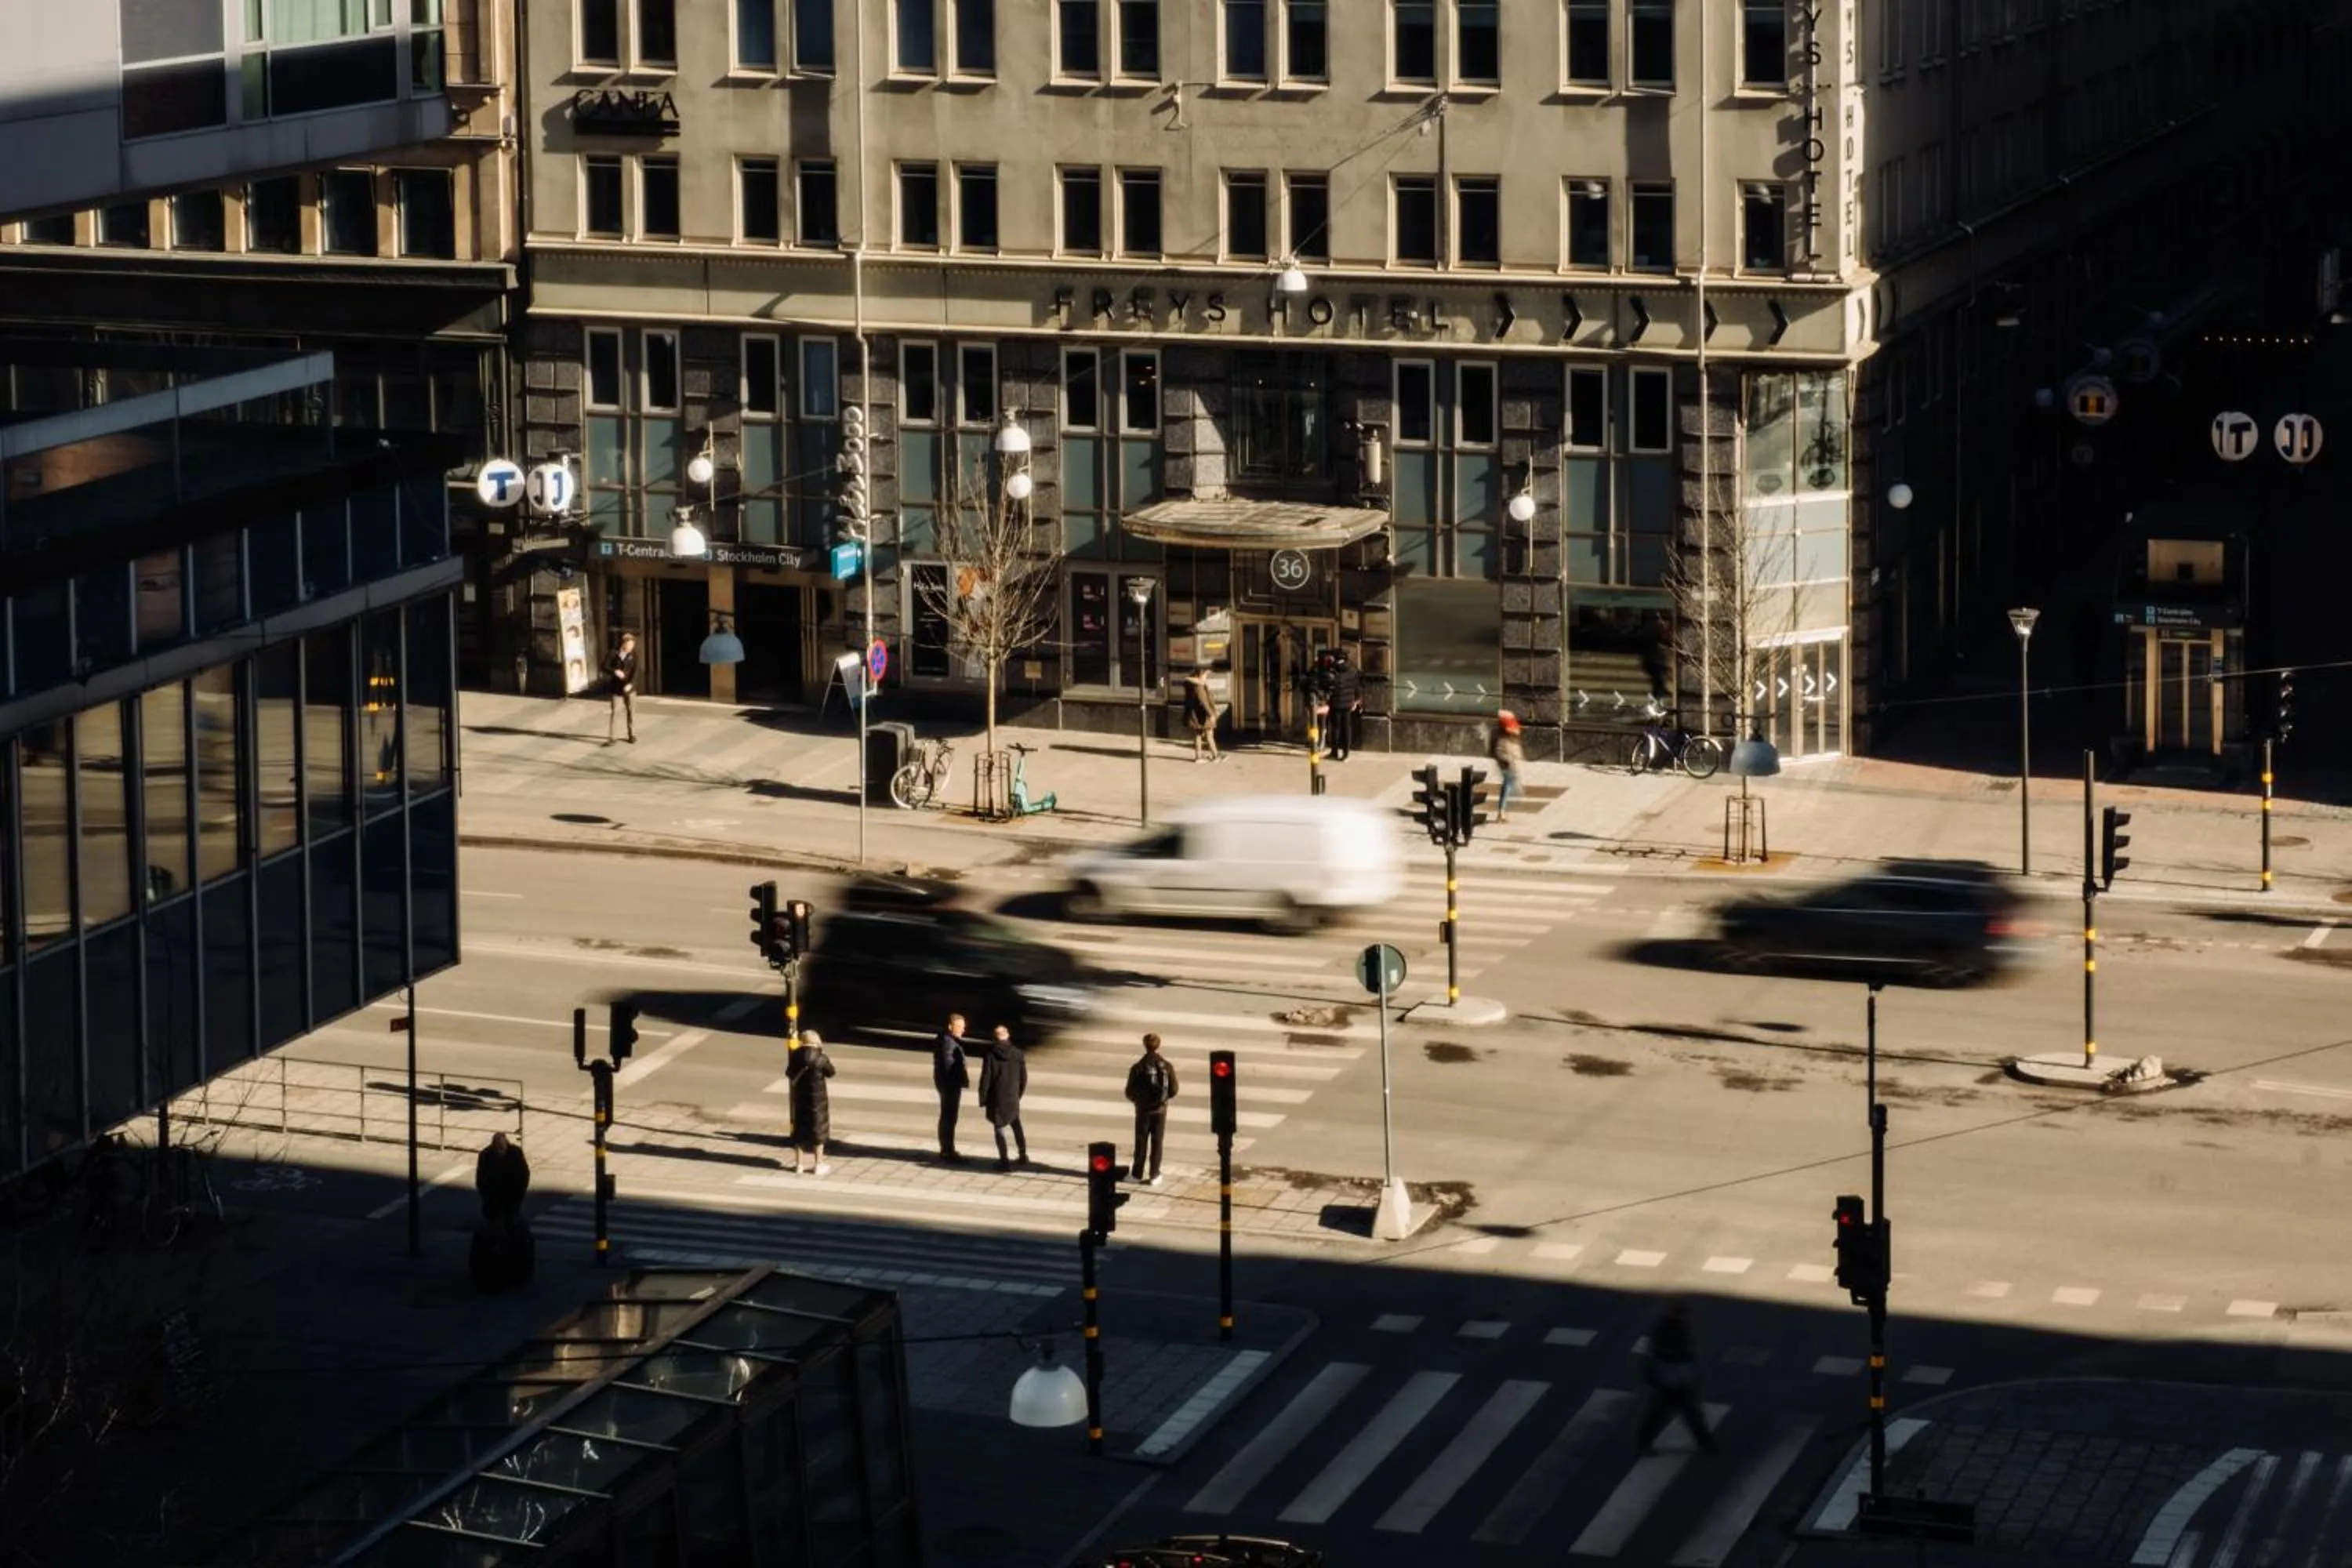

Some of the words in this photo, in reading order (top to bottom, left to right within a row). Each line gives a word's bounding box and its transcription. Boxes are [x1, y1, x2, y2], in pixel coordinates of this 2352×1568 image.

[1803, 106, 1824, 259] HOTEL
[1054, 285, 1227, 323] FREYS
[1267, 292, 1449, 329] HOTEL
[2230, 421, 2252, 455] T
[487, 470, 516, 501] T
[717, 549, 775, 564] Stockholm
[779, 553, 801, 568] City
[1277, 559, 1302, 579] 36
